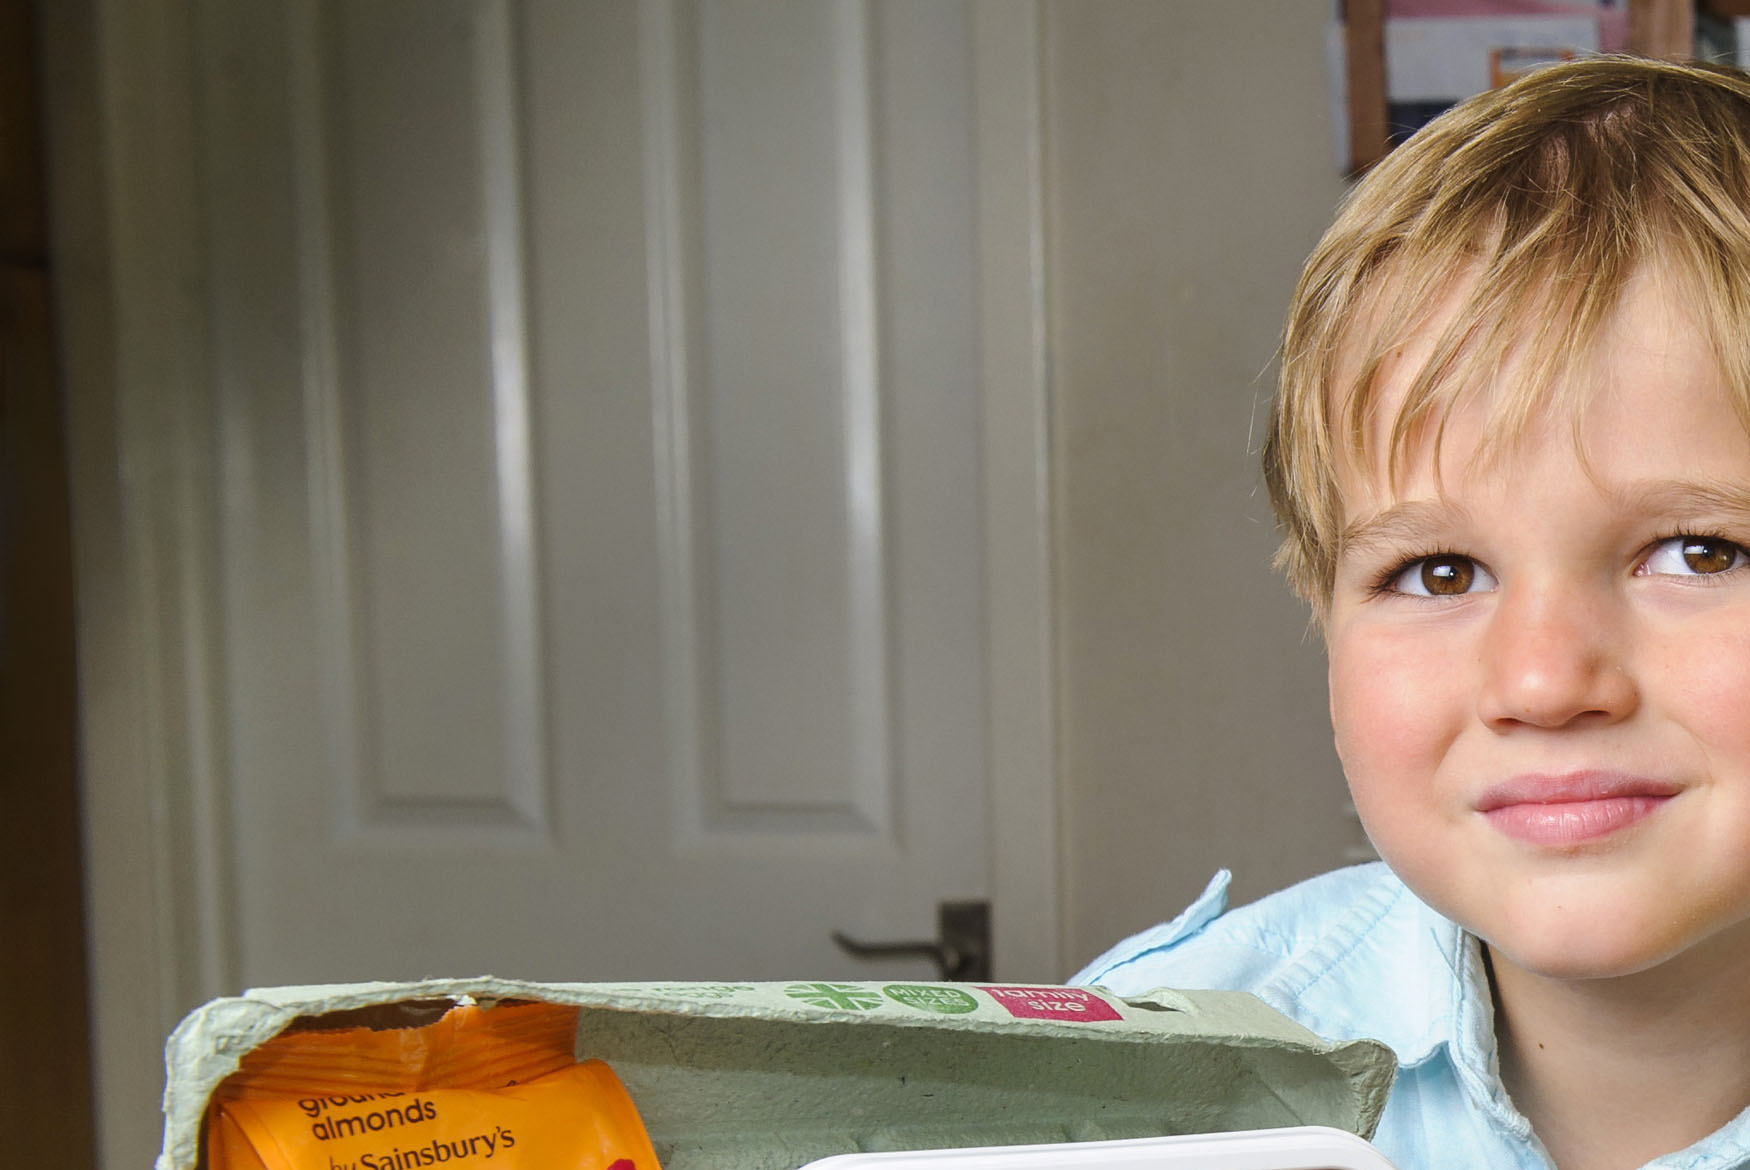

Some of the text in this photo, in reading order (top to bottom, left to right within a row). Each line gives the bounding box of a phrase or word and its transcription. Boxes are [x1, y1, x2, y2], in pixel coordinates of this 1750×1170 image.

[891, 987, 961, 998] MIXED
[902, 996, 970, 1007] SIZES
[1028, 999, 1086, 1012] size
[312, 1097, 436, 1141] almonds
